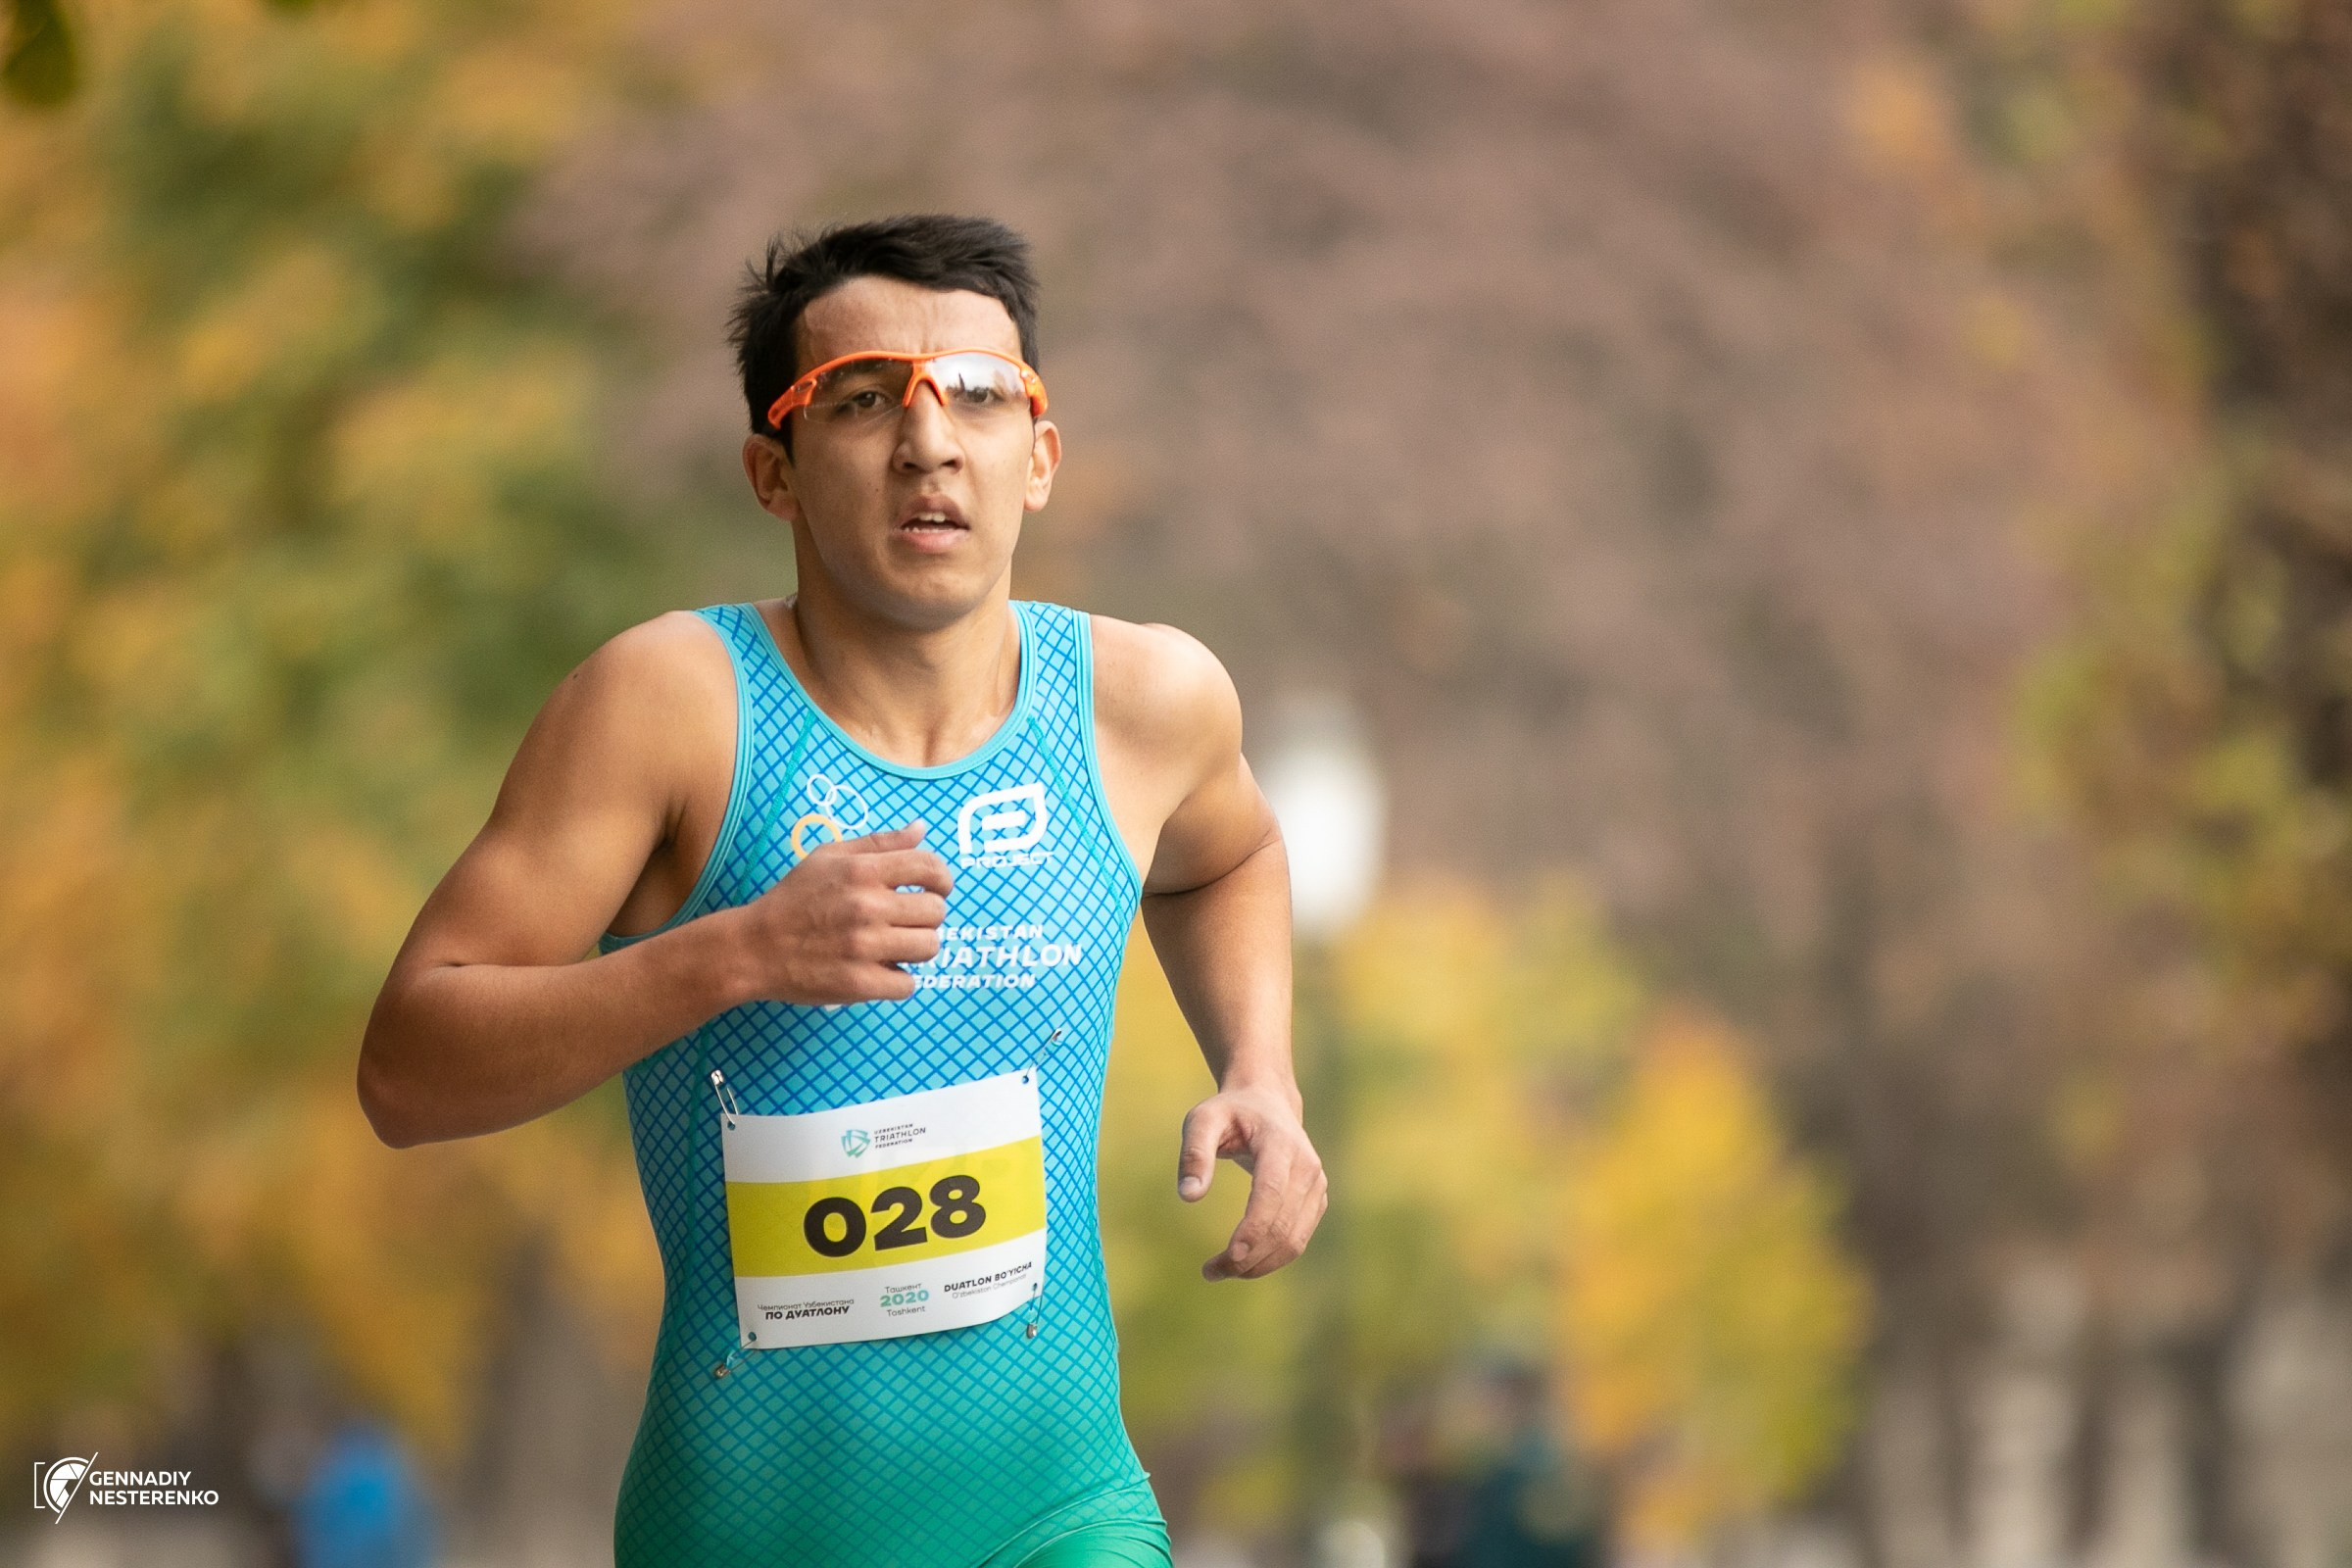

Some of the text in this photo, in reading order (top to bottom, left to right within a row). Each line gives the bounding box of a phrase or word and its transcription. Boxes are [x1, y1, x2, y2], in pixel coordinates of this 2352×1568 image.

[959, 851, 1054, 869] PROJECT
[900, 944, 1083, 968] IATHLON
[913, 973, 1036, 989] EDERATION
[874, 1123, 913, 1135] UZBEKISTAN
[874, 1127, 926, 1143] TRIATHLON
[875, 1139, 912, 1149] FEDERATION
[804, 1174, 986, 1257] 028
[884, 1283, 922, 1294] Ташкент
[944, 1275, 992, 1293] DUATLON
[804, 1298, 855, 1309] Узбекистана
[880, 1290, 929, 1307] 2020
[765, 1305, 850, 1320] ПО ДУАТЛОНУ
